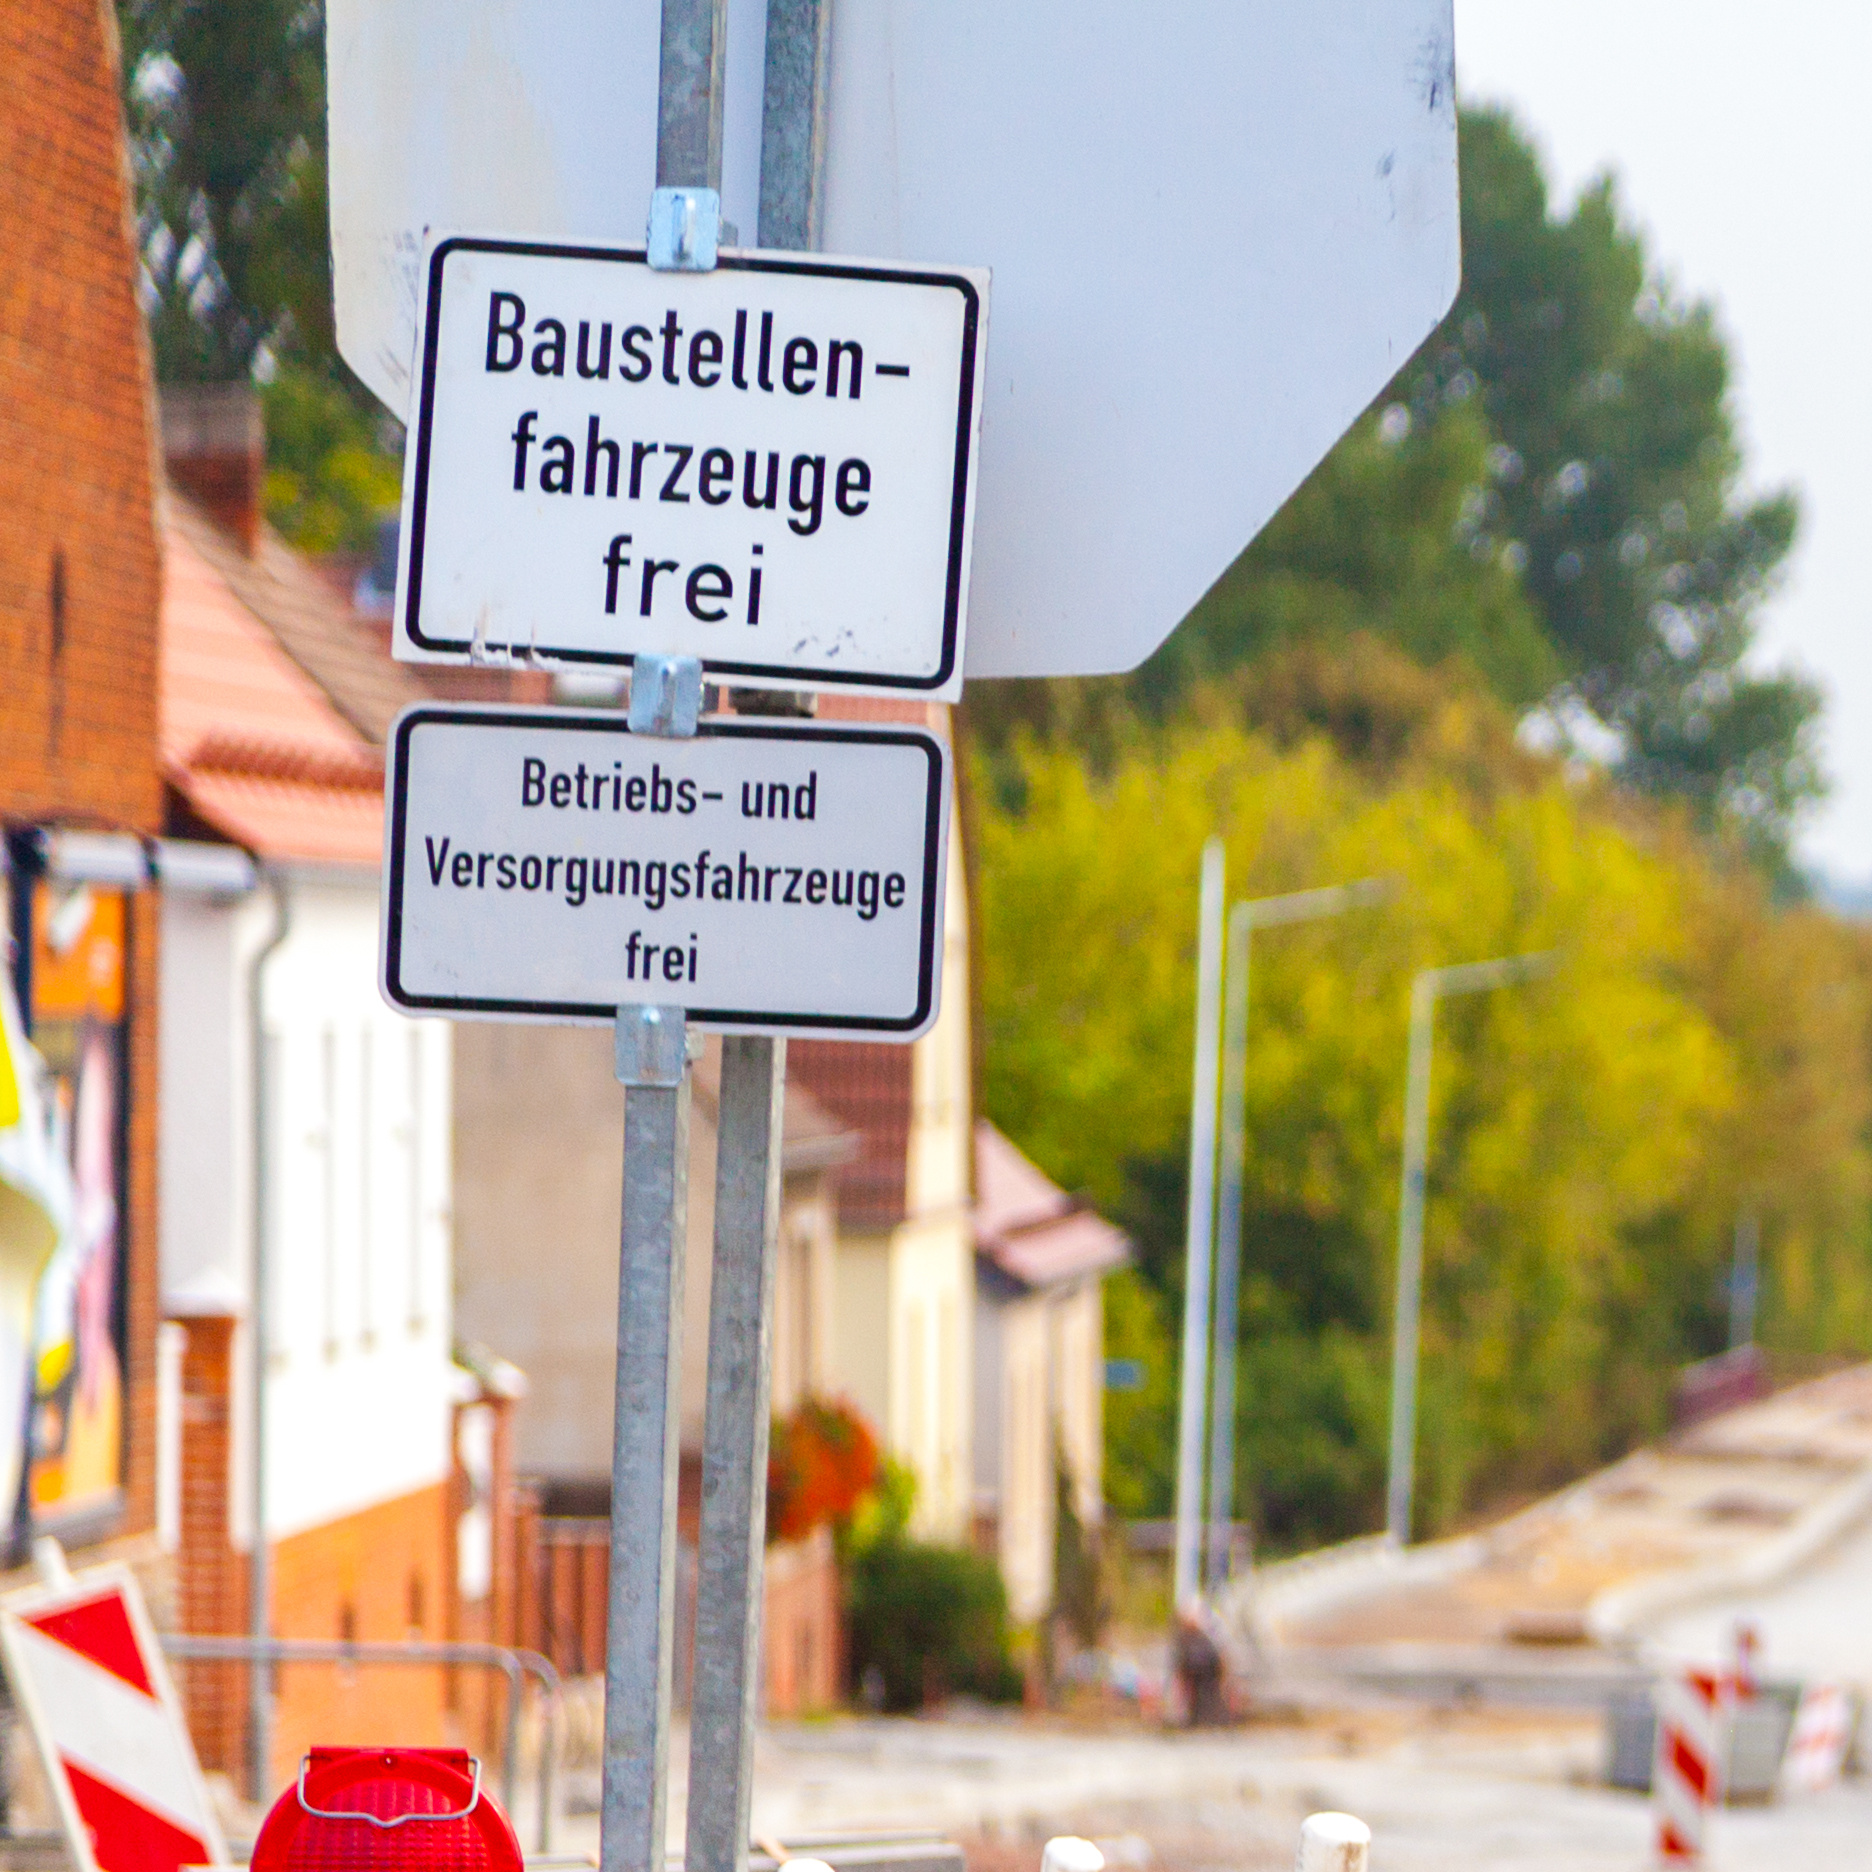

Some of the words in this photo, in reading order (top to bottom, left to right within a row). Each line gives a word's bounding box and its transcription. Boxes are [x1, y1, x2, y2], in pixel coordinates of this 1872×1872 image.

[485, 290, 911, 400] Baustellen-
[511, 411, 871, 536] fahrzeuge
[602, 534, 763, 627] frei
[521, 757, 725, 818] Betriebs-
[741, 771, 818, 821] und
[425, 836, 906, 921] Versorgungsfahrzeuge
[625, 930, 698, 983] frei
